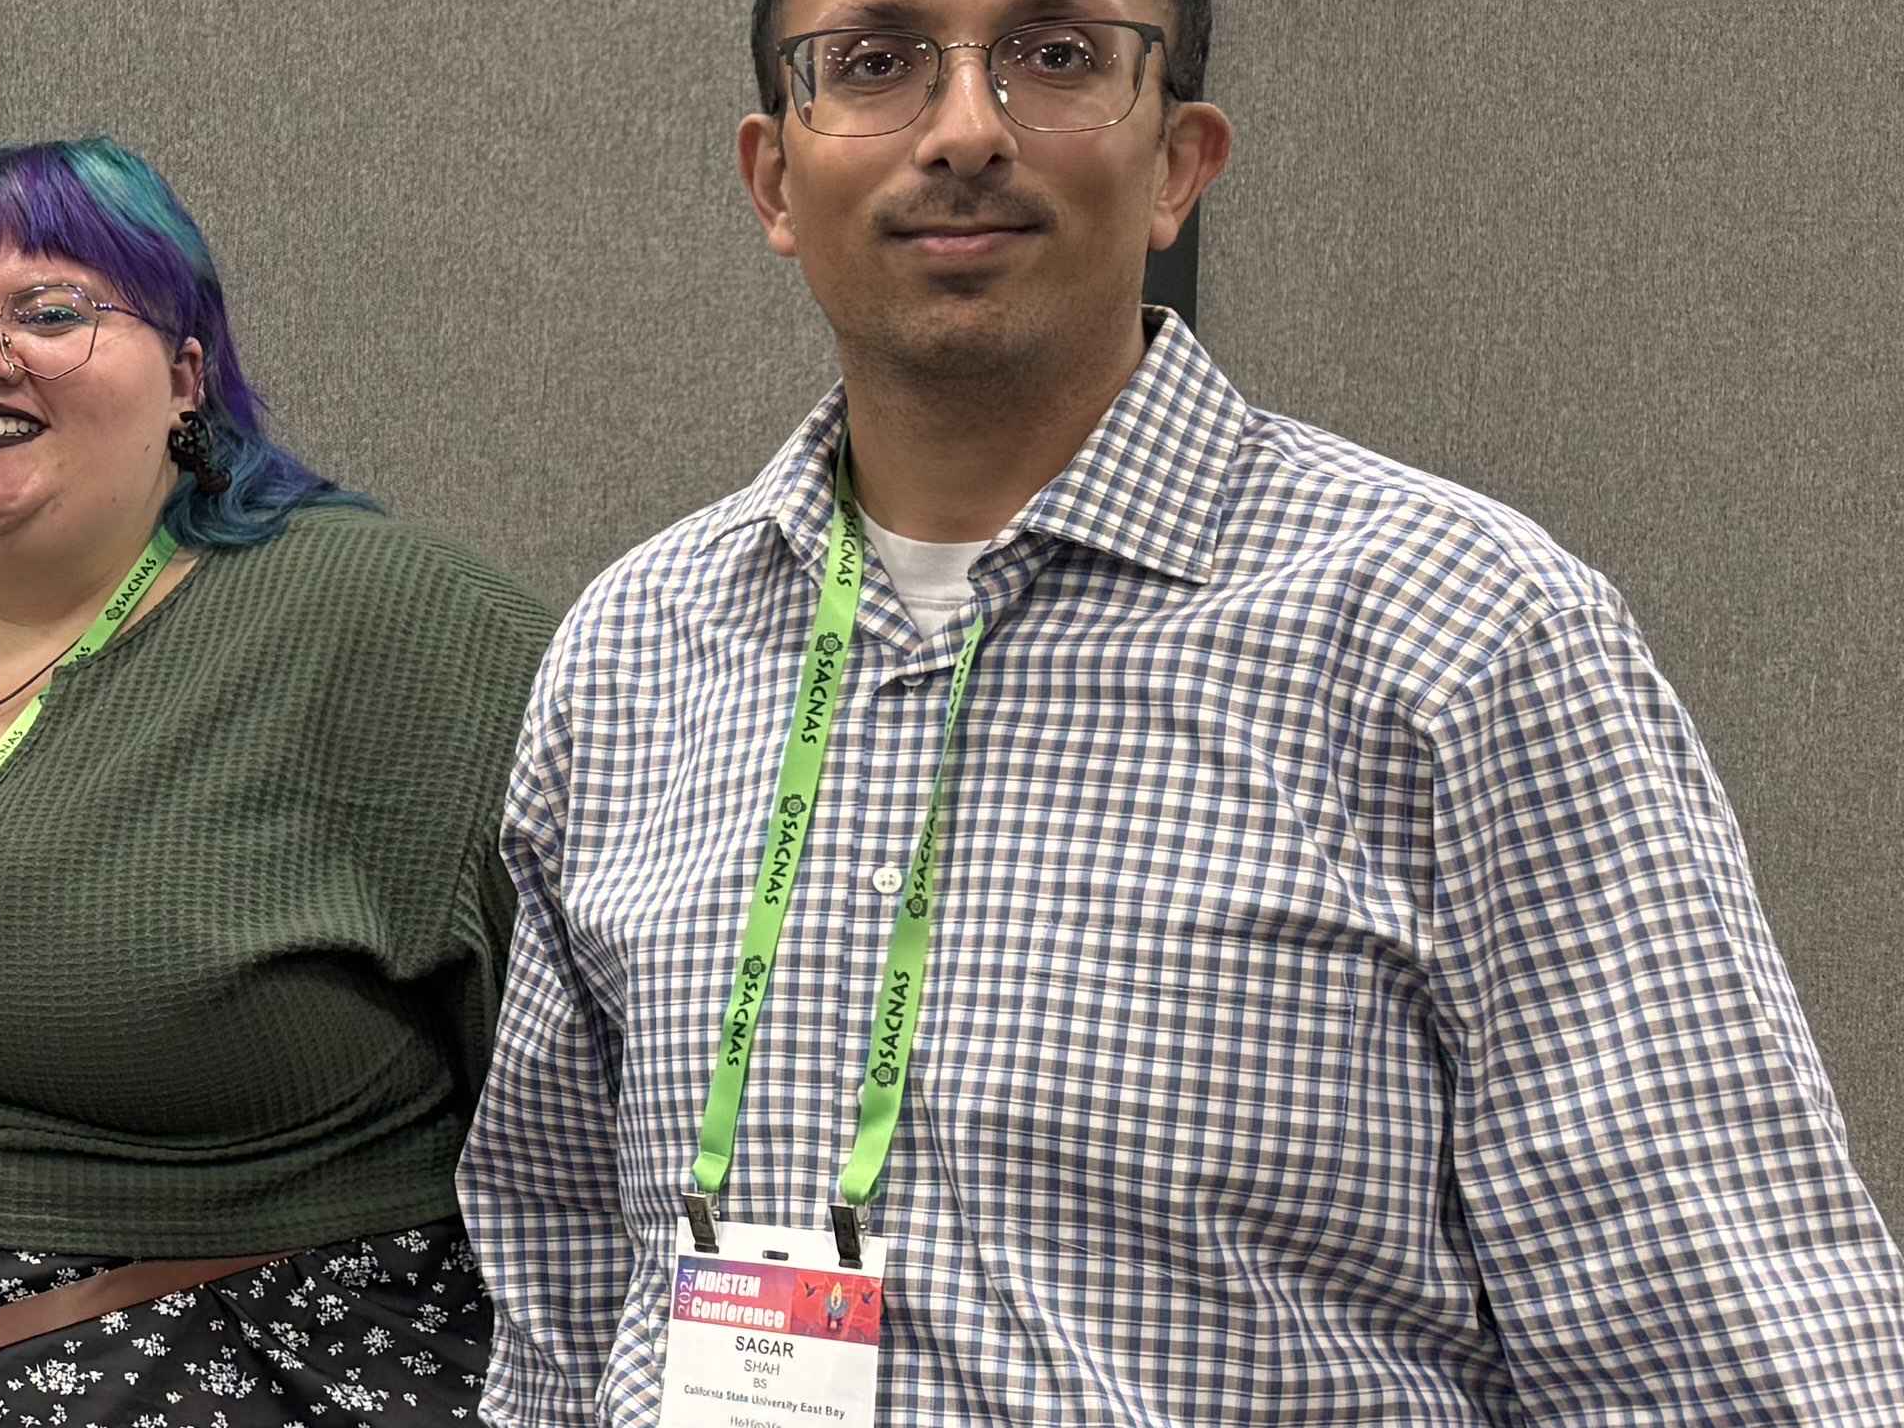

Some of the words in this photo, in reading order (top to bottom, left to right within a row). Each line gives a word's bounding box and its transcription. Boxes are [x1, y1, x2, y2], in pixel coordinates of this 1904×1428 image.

[118, 557, 157, 607] SACNAS
[801, 657, 835, 744] SACNAS
[765, 820, 798, 905] SACNAS
[727, 981, 758, 1066] SACNAS
[879, 970, 910, 1060] SACNAS
[694, 1270, 761, 1298] NDISTEM
[691, 1296, 785, 1328] Conference
[735, 1336, 794, 1358] SAGAR
[744, 1360, 780, 1376] SHAH
[753, 1378, 767, 1389] BS
[684, 1384, 723, 1400] California
[727, 1391, 749, 1403] State
[752, 1395, 798, 1413] University
[800, 1402, 822, 1415] East
[825, 1406, 846, 1420] Bay
